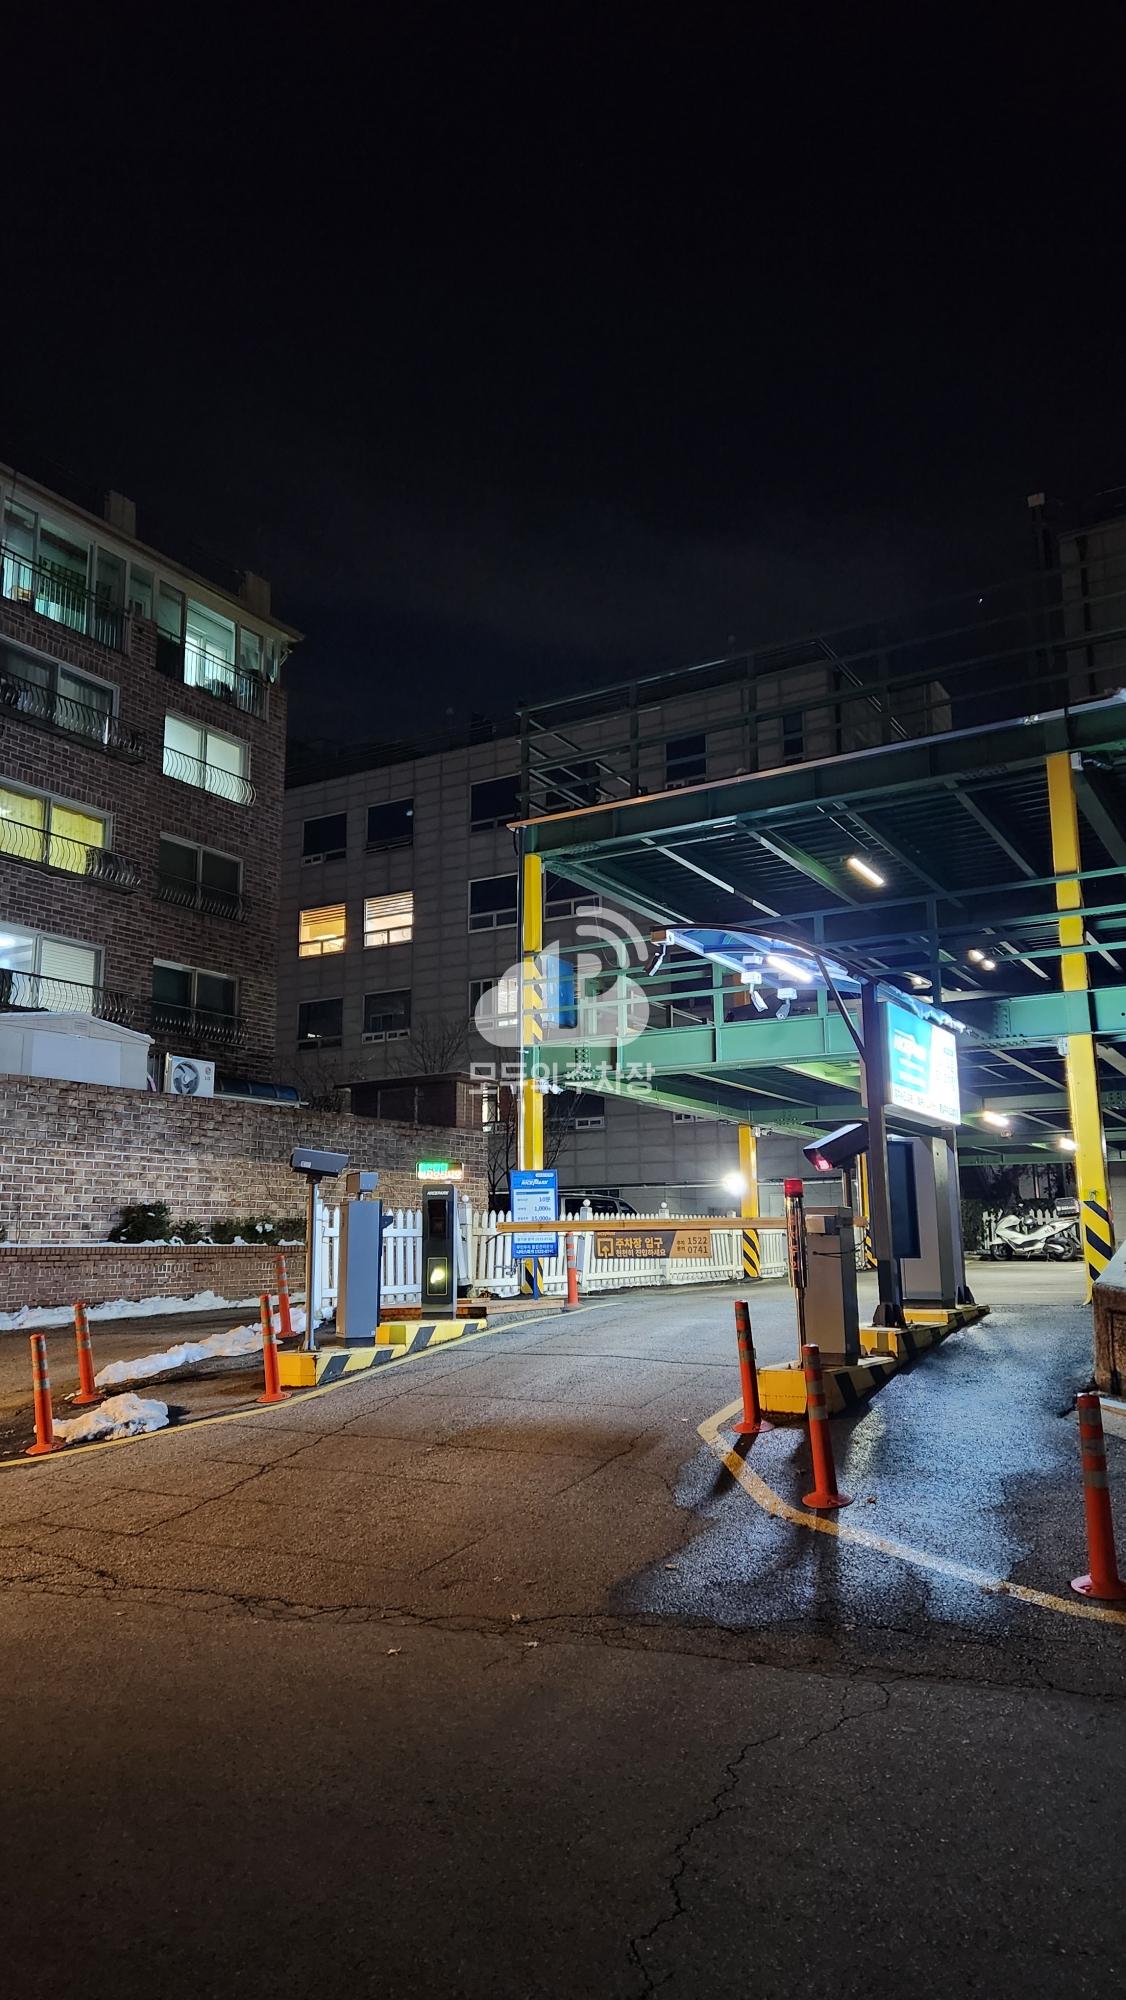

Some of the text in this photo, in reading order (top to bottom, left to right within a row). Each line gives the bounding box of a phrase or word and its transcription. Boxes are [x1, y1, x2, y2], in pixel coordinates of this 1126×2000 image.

[615, 1236, 663, 1249] 주차장 입구
[688, 1237, 708, 1245] 1522
[616, 1249, 666, 1257] 천천히 진입하세요
[688, 1245, 709, 1254] 0741
